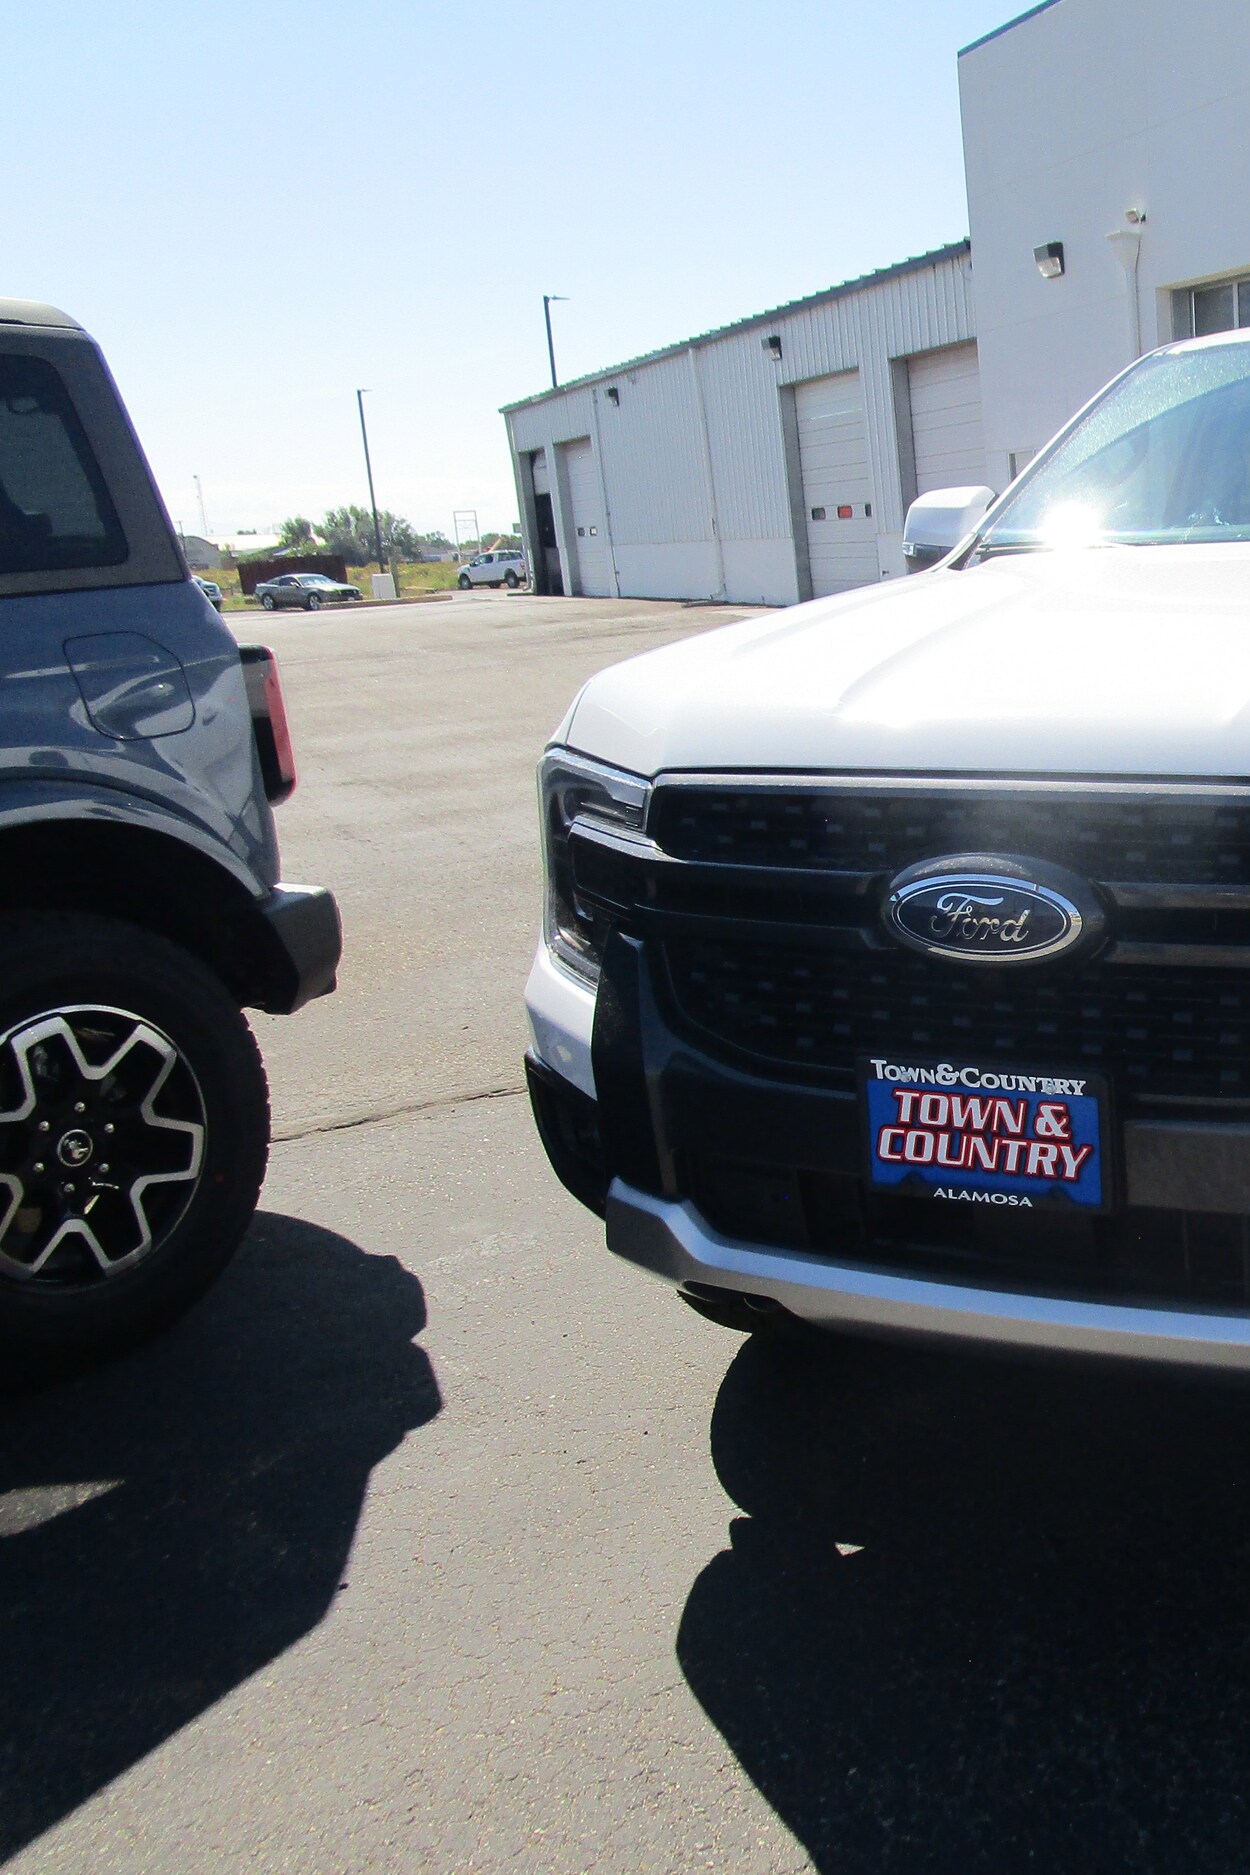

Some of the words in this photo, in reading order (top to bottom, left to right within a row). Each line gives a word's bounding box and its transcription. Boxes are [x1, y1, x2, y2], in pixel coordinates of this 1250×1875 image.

[931, 892, 1031, 942] Ford
[895, 1090, 1025, 1133] TOWN
[1035, 1105, 1069, 1137] &
[878, 1128, 1088, 1178] COUNTRY
[933, 1187, 1033, 1207] ALAMOSA
